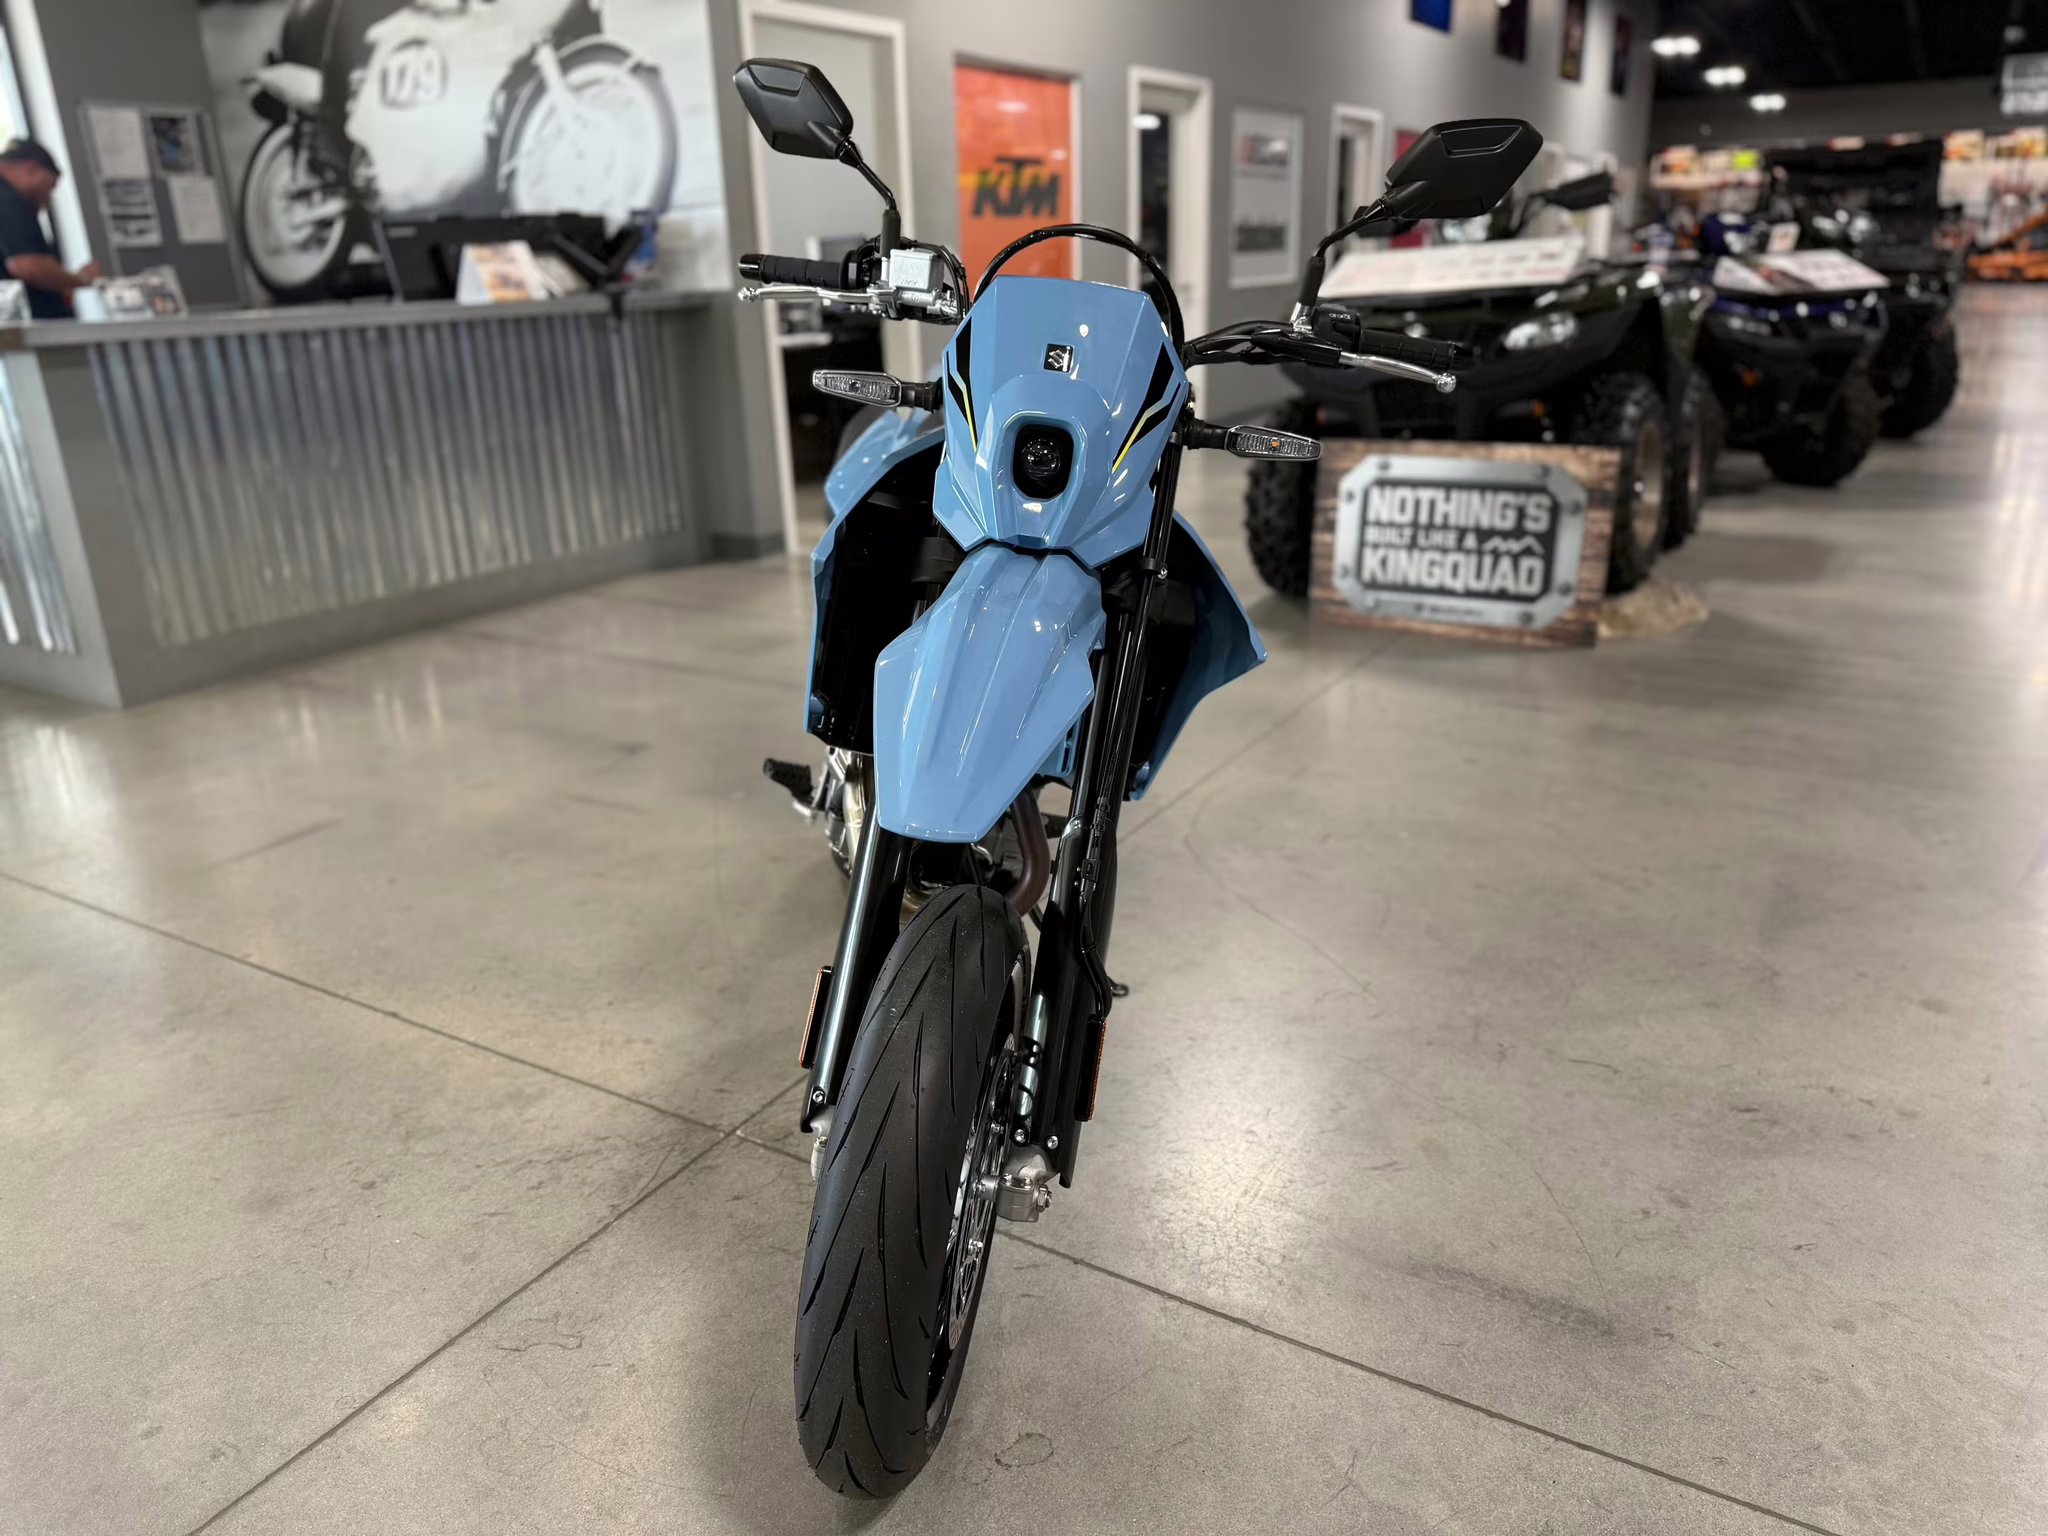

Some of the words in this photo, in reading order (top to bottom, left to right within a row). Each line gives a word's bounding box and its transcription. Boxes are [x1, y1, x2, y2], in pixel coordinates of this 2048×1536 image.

[972, 156, 1062, 217] KTM
[1366, 484, 1552, 534] NOTHING'S
[1363, 525, 1413, 545] BUILT
[1417, 528, 1457, 549] LIKE
[1462, 532, 1479, 550] A
[1361, 547, 1545, 597] KINGQUAD
